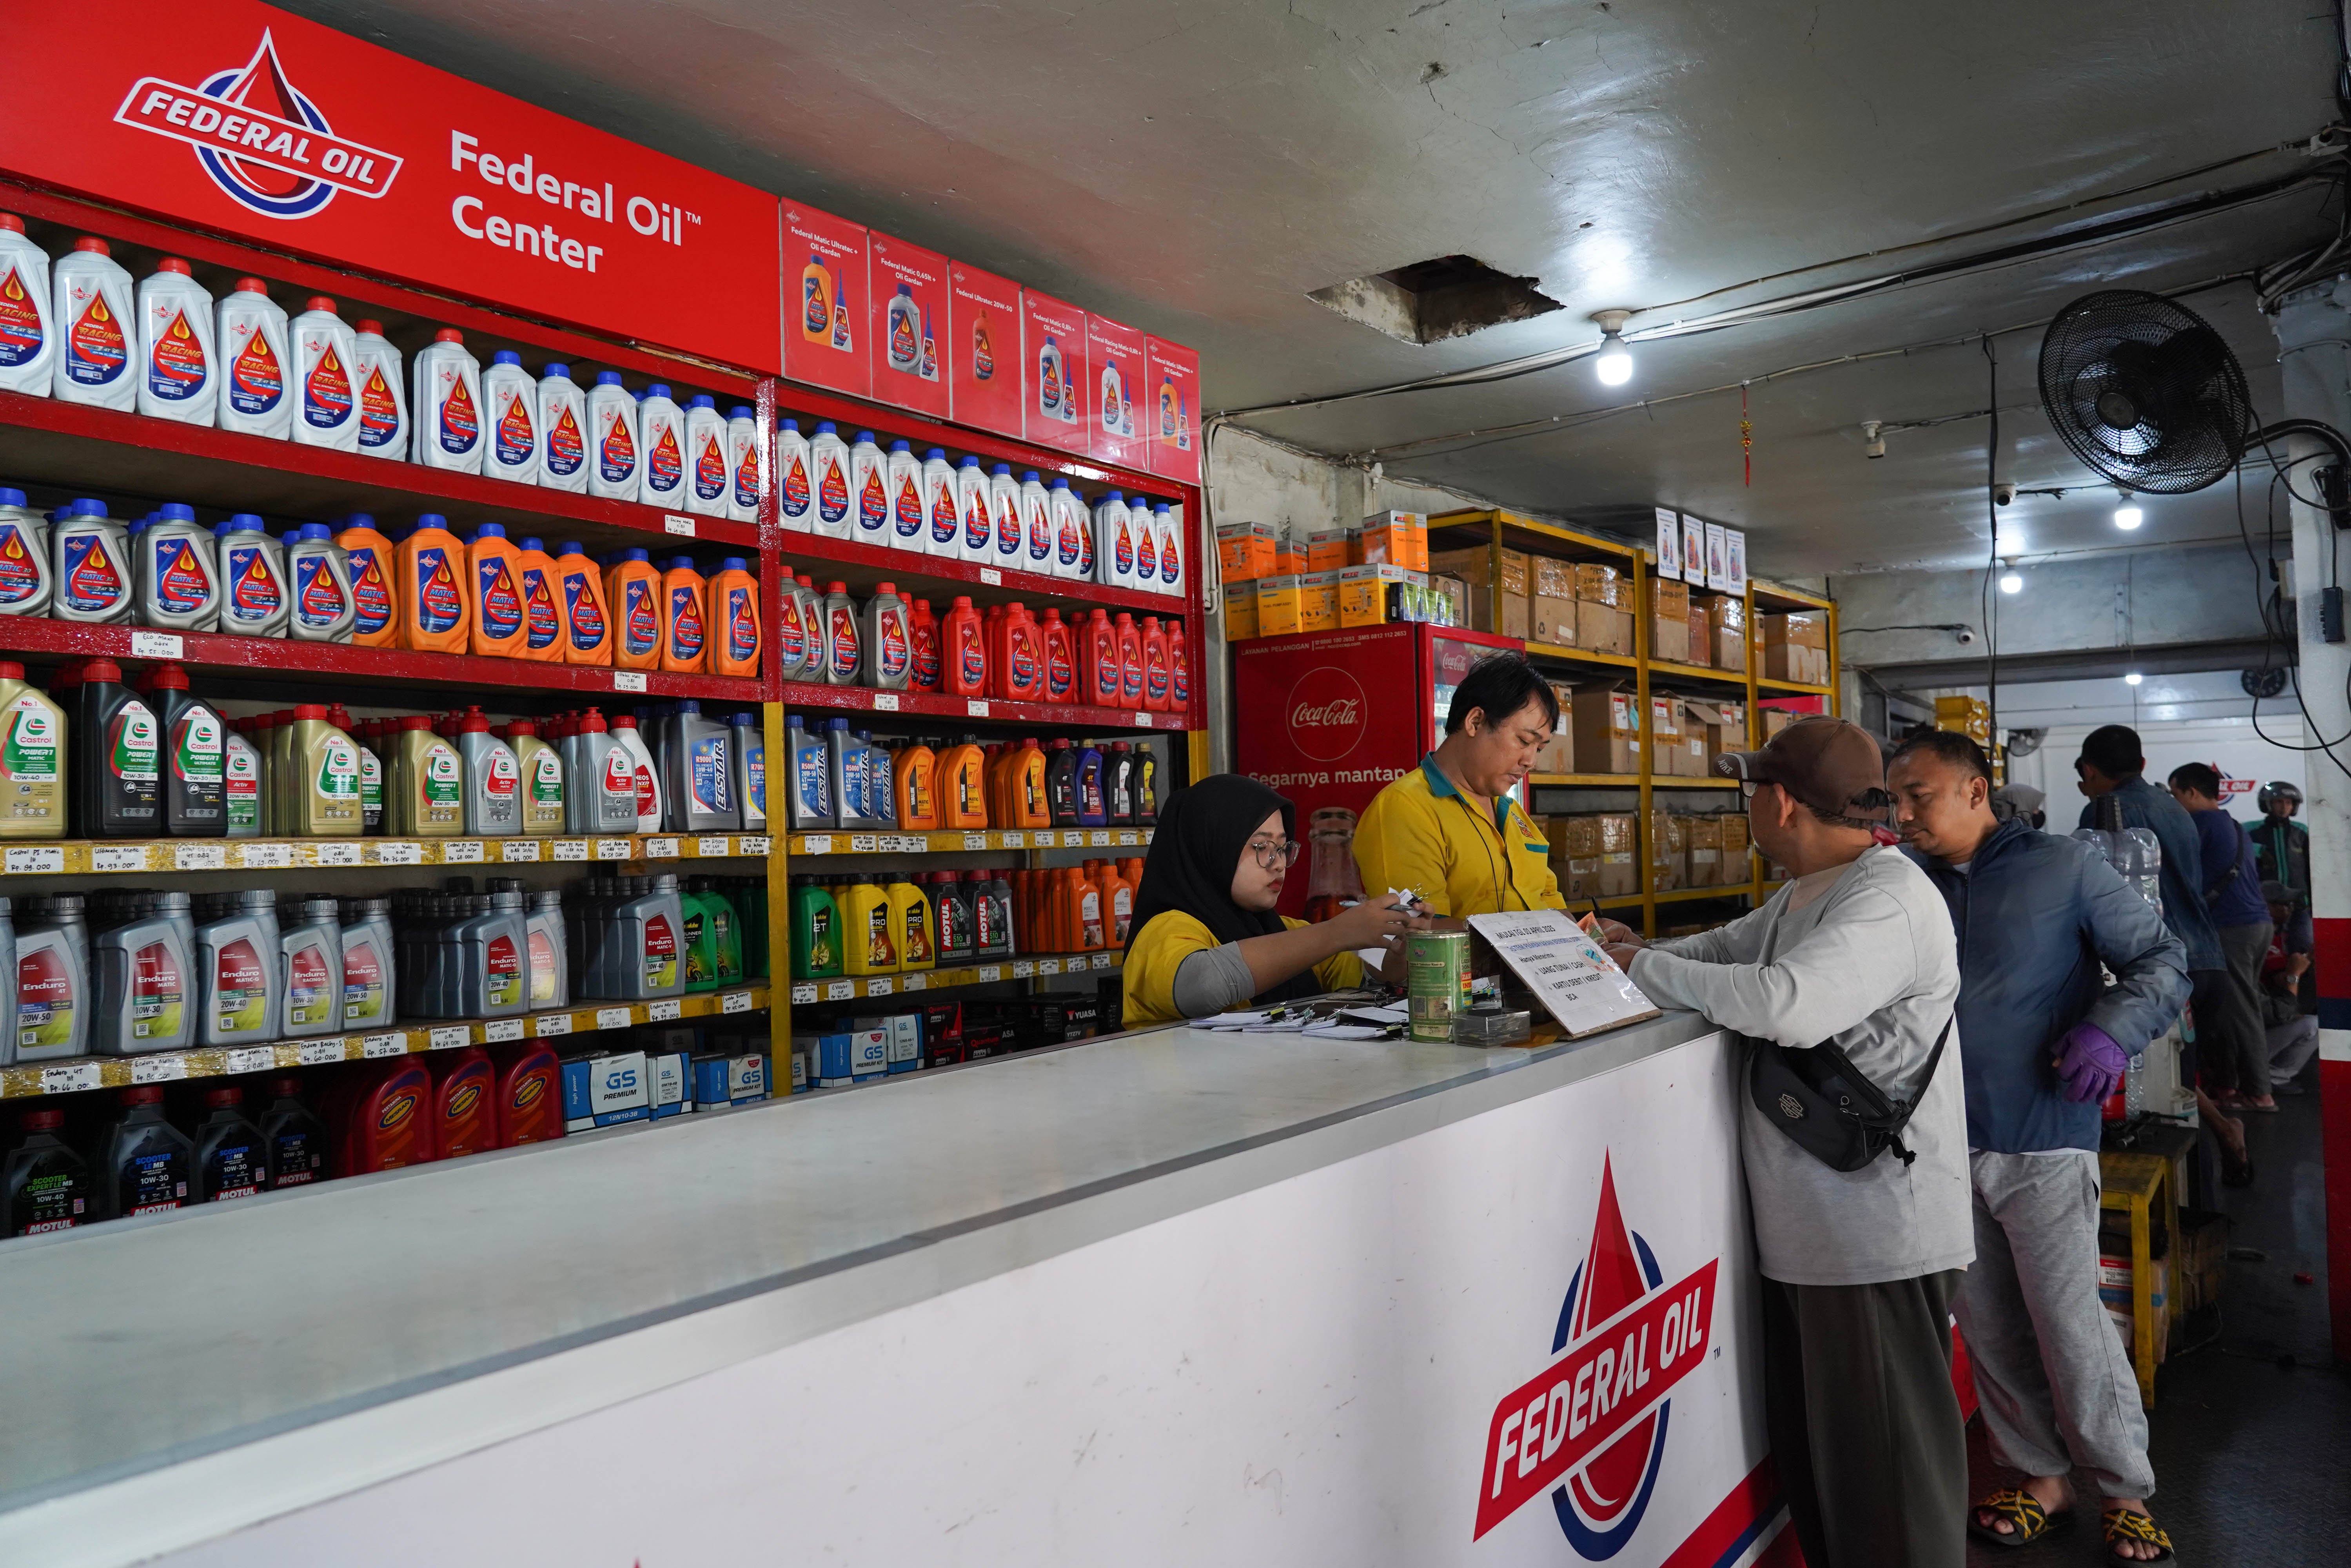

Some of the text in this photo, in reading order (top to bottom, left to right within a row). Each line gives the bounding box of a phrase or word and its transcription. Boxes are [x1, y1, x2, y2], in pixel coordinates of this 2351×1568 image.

[140, 90, 376, 185] FEDERAL OIL
[451, 129, 613, 224] Federal
[451, 196, 603, 273] Center
[791, 226, 853, 253] Federal Matic Ultratec
[821, 246, 841, 258] Gardan
[881, 258, 900, 270] Federal
[901, 265, 915, 275] Matic
[904, 275, 922, 287] Gardan
[956, 288, 1012, 312] Federal Ultratec 20W-50
[1033, 313, 1049, 323] Federal
[77, 326, 122, 341] RACING
[1051, 327, 1066, 336] Gardan
[1090, 334, 1129, 351] Federal Racing Matic
[160, 343, 202, 358] RACING
[1113, 350, 1126, 358] Gardan
[1153, 356, 1165, 364] Federal
[1242, 647, 1269, 655] LAYANAN
[1271, 643, 1309, 652] PELANGGAN
[1292, 698, 1360, 728] Coca-Cola
[1718, 759, 1733, 774] NIKE
[714, 739, 726, 811] ECSTAR
[817, 748, 827, 815] ECSTAR
[1248, 766, 1407, 789] Segarnya mantap
[861, 750, 870, 815] ECSTAR
[942, 903, 951, 947] MOTUL
[1496, 929, 1516, 939] MULAI
[1538, 966, 1556, 975] UANG
[1569, 978, 1584, 986] DEBIT
[1585, 973, 1603, 982] KREDIT
[136, 1005, 160, 1014] 10W-30
[221, 1000, 246, 1008] 20W-40
[22, 1013, 50, 1022] 20W-50
[1075, 1009, 1096, 1019] YUASA
[606, 1069, 636, 1090] GS
[741, 1070, 761, 1084] GS
[449, 1085, 467, 1103] PERTAMINA
[604, 1089, 637, 1100] PREMIUM
[733, 1085, 753, 1093] PREMIUM
[451, 1089, 478, 1115] MESRAN
[608, 1111, 638, 1122] 12N10-3B
[136, 1153, 171, 1165] SCOOTER
[33, 1175, 67, 1184] SCOOTER
[140, 1175, 169, 1184] 10W-30
[27, 1183, 53, 1192] EXPERT
[219, 1186, 256, 1201] MOTUL
[36, 1194, 64, 1203] 10W-40
[28, 1218, 73, 1234] MOTUL
[1492, 1287, 1703, 1499] FEDERAL OIL
